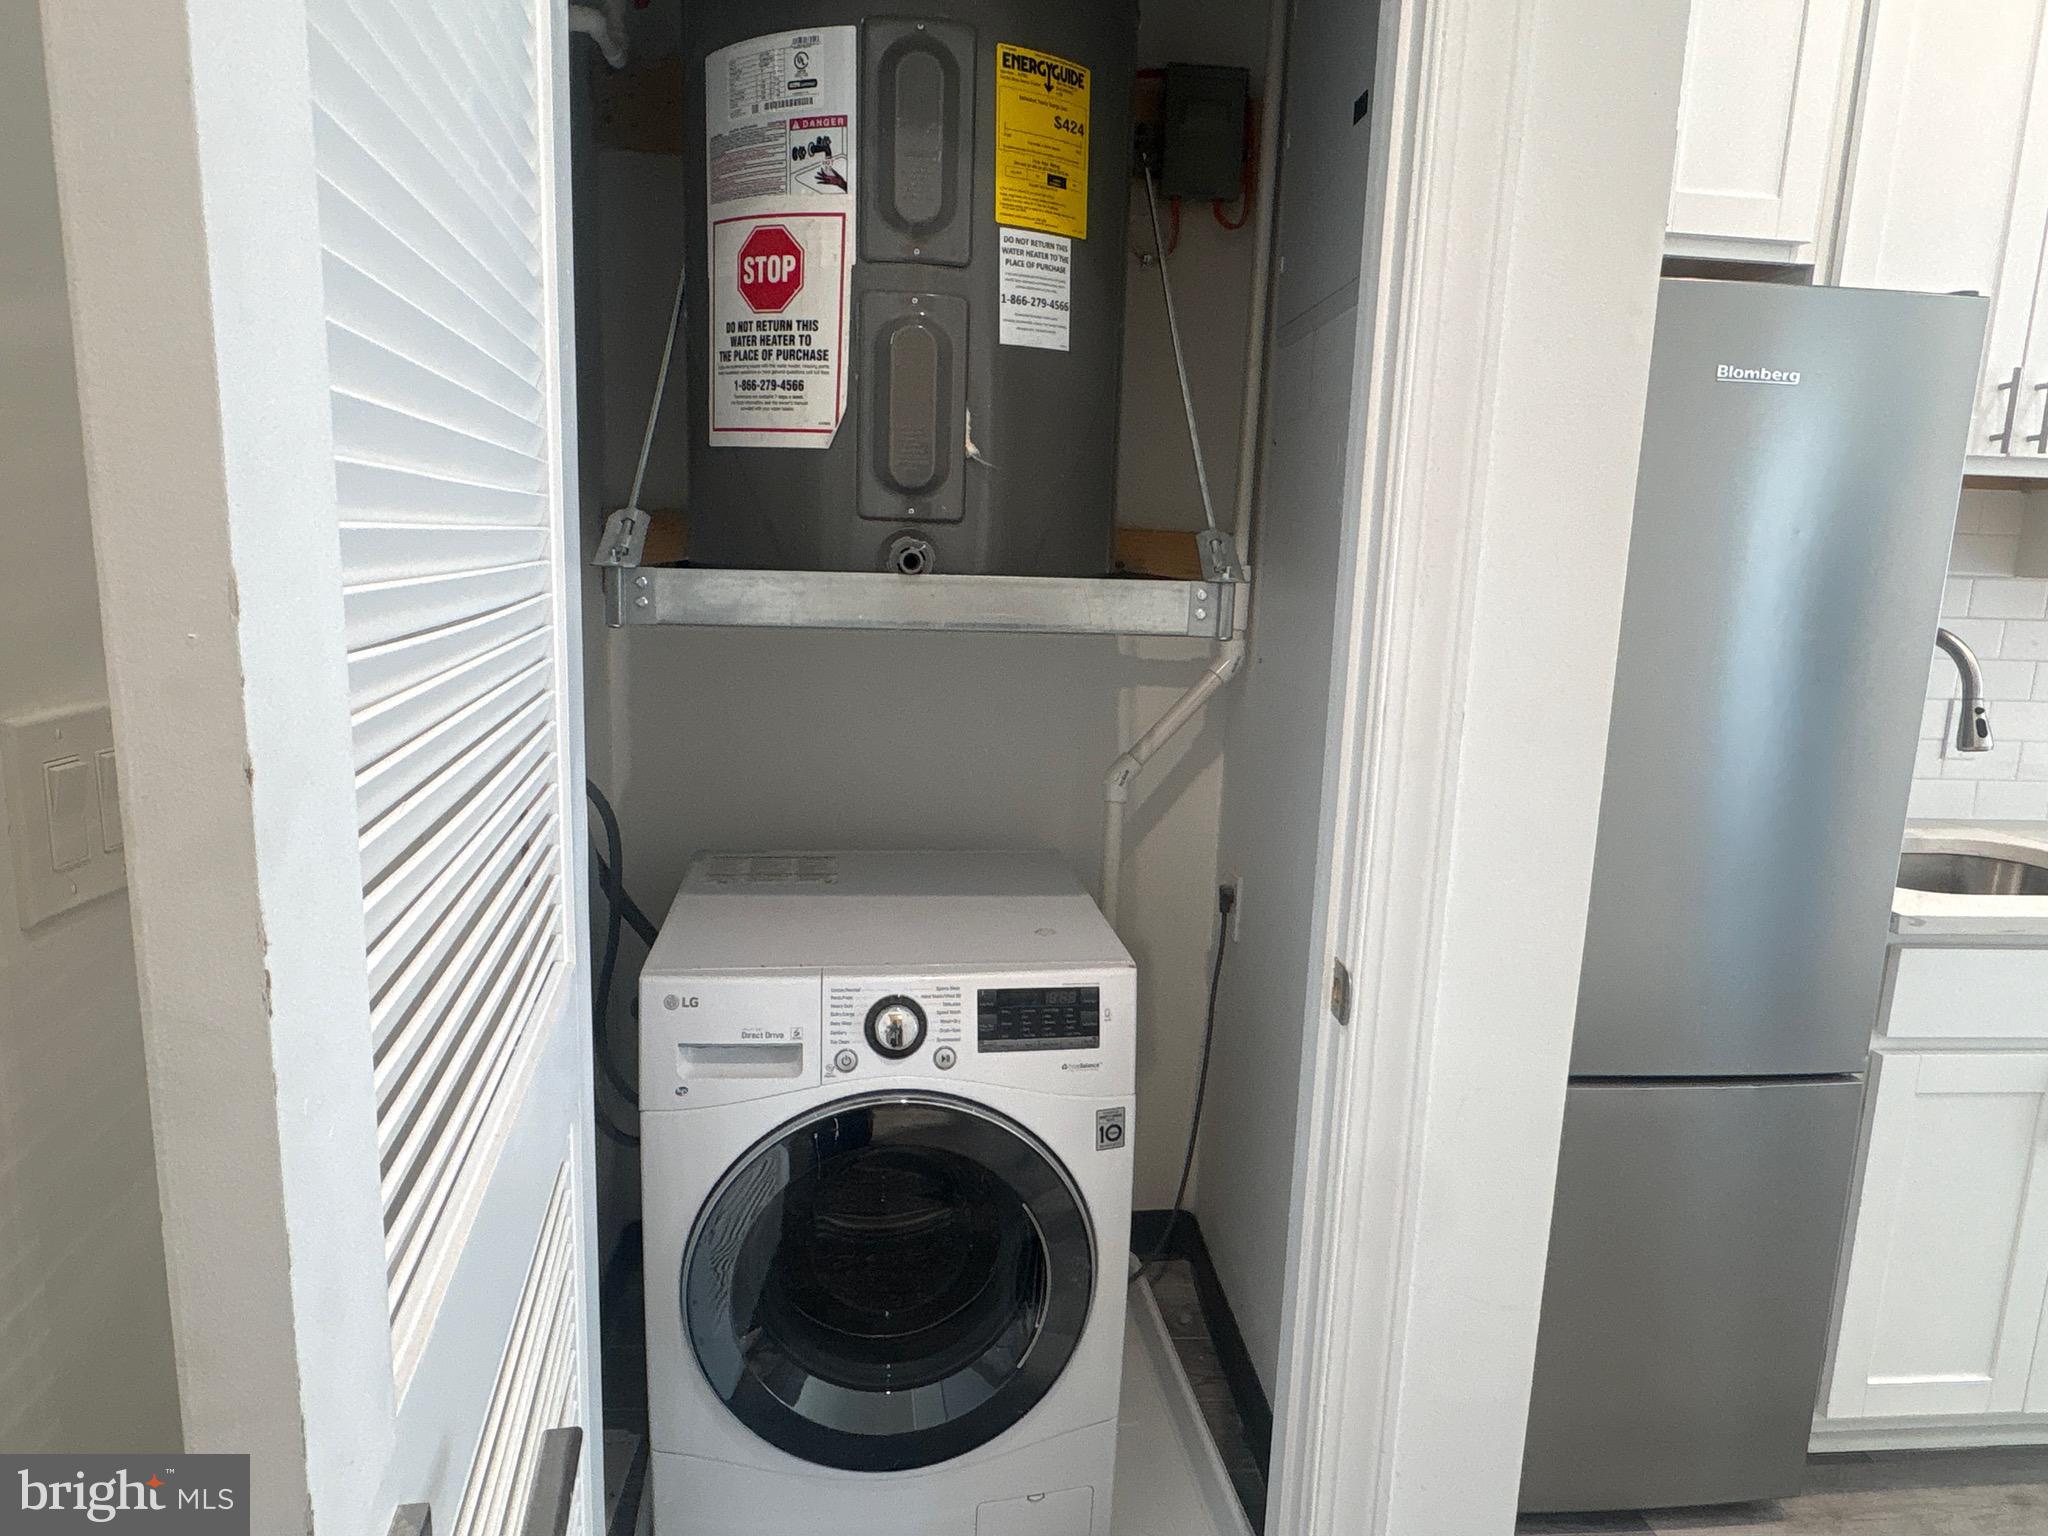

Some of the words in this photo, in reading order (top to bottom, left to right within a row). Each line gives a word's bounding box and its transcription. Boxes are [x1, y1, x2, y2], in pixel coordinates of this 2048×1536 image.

[1002, 52, 1085, 90] ENERGYGUIDE
[802, 118, 844, 128] DANGER
[1054, 116, 1085, 136] $424
[1003, 235, 1014, 244] DO
[1016, 237, 1030, 246] NOT
[1030, 240, 1055, 250] RETURN
[1056, 242, 1068, 252] THIS
[1002, 247, 1024, 256] WATER
[1025, 250, 1048, 260] HEATER
[1050, 253, 1058, 262] TO
[1058, 254, 1069, 264] THE
[743, 254, 796, 284] STOP
[1004, 258, 1025, 268] PLACE
[1026, 260, 1036, 268] OF
[1036, 262, 1066, 274] PURCHASE
[1000, 294, 1069, 311] 1-866-279-4566
[726, 322, 736, 332] DO
[738, 321, 754, 332] NOT
[756, 320, 793, 332] RETURN
[796, 319, 819, 332] THIS
[730, 335, 757, 347] WATER
[760, 334, 796, 346] HEATER
[798, 334, 812, 346] TO
[719, 350, 732, 362] THE
[734, 350, 760, 362] PLACE
[762, 350, 774, 360] OF
[776, 349, 829, 361] PURCHASE
[1716, 364, 1801, 384] Blomberg
[734, 380, 804, 392] 1-866-279-4566
[682, 997, 699, 1008] LG
[741, 1030, 764, 1040] Direct
[765, 1031, 784, 1040] Drive
[1099, 1124, 1122, 1144] 10
